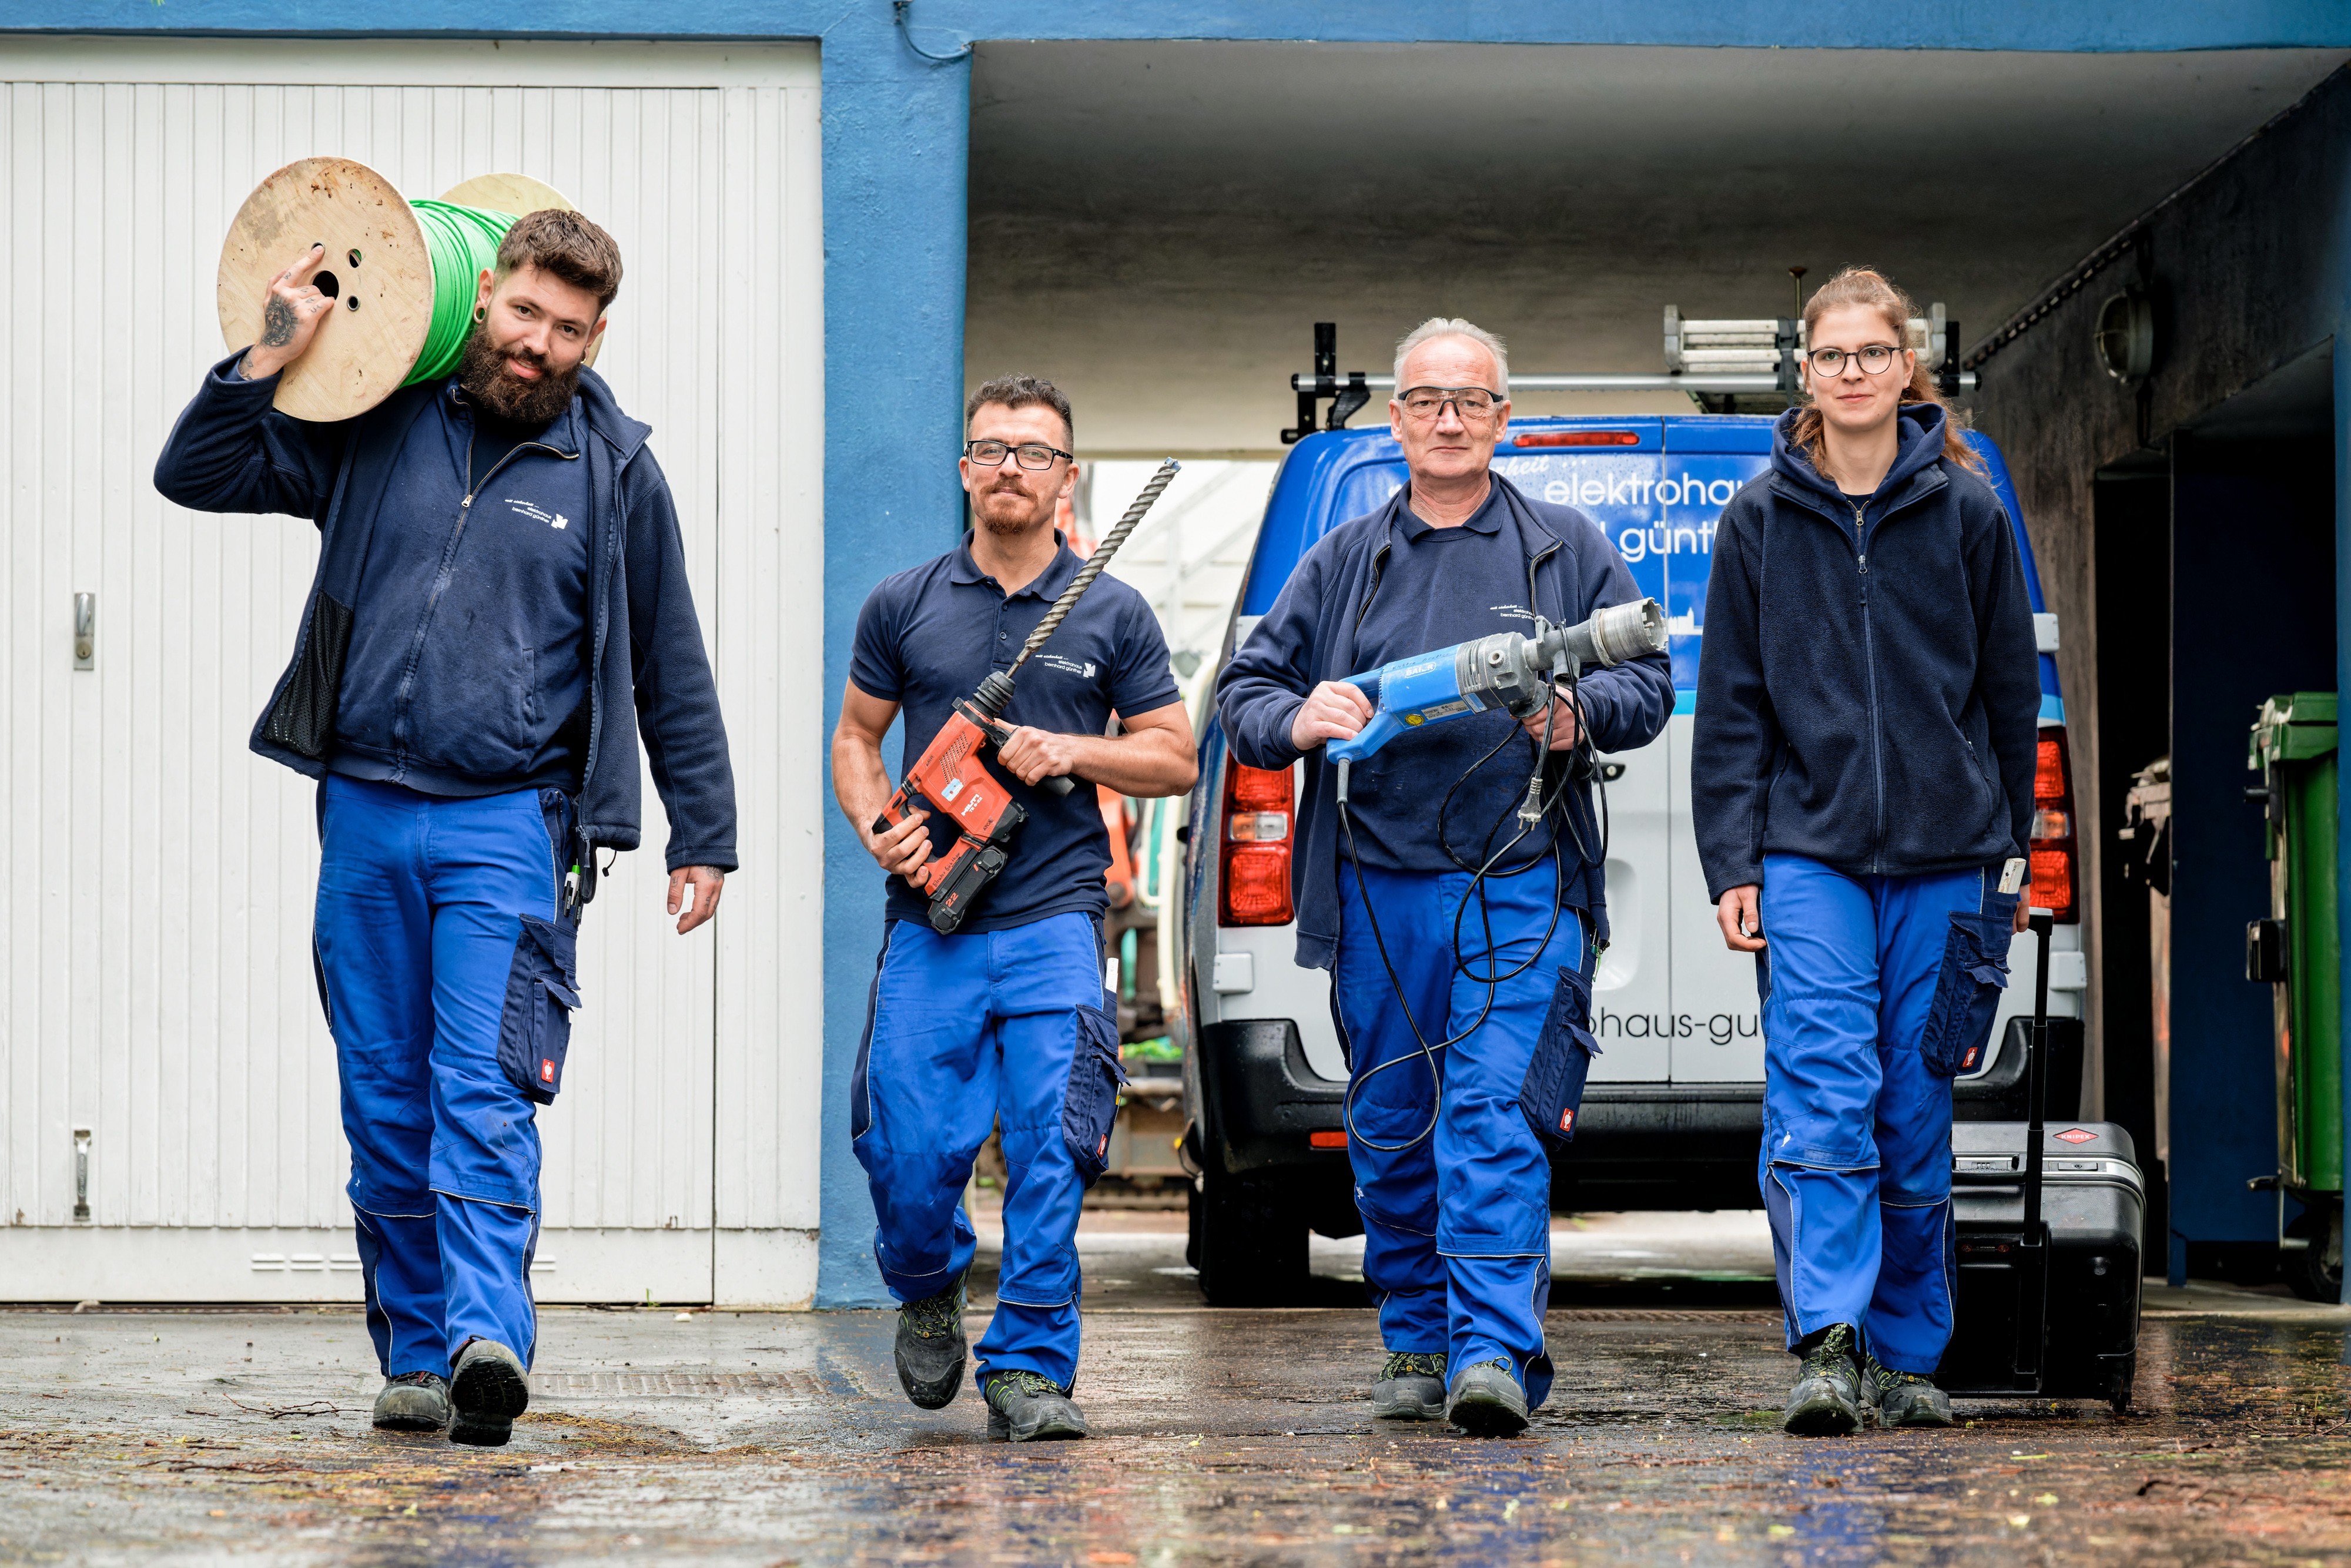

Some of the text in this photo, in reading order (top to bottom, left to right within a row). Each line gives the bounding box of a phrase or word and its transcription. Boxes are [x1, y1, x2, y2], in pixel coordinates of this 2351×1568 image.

[512, 507, 533, 517] bernhard
[527, 507, 552, 520] elektrohaus
[1058, 659, 1082, 669] elektrohaus
[961, 793, 979, 816] HILTI
[946, 892, 959, 907] 22
